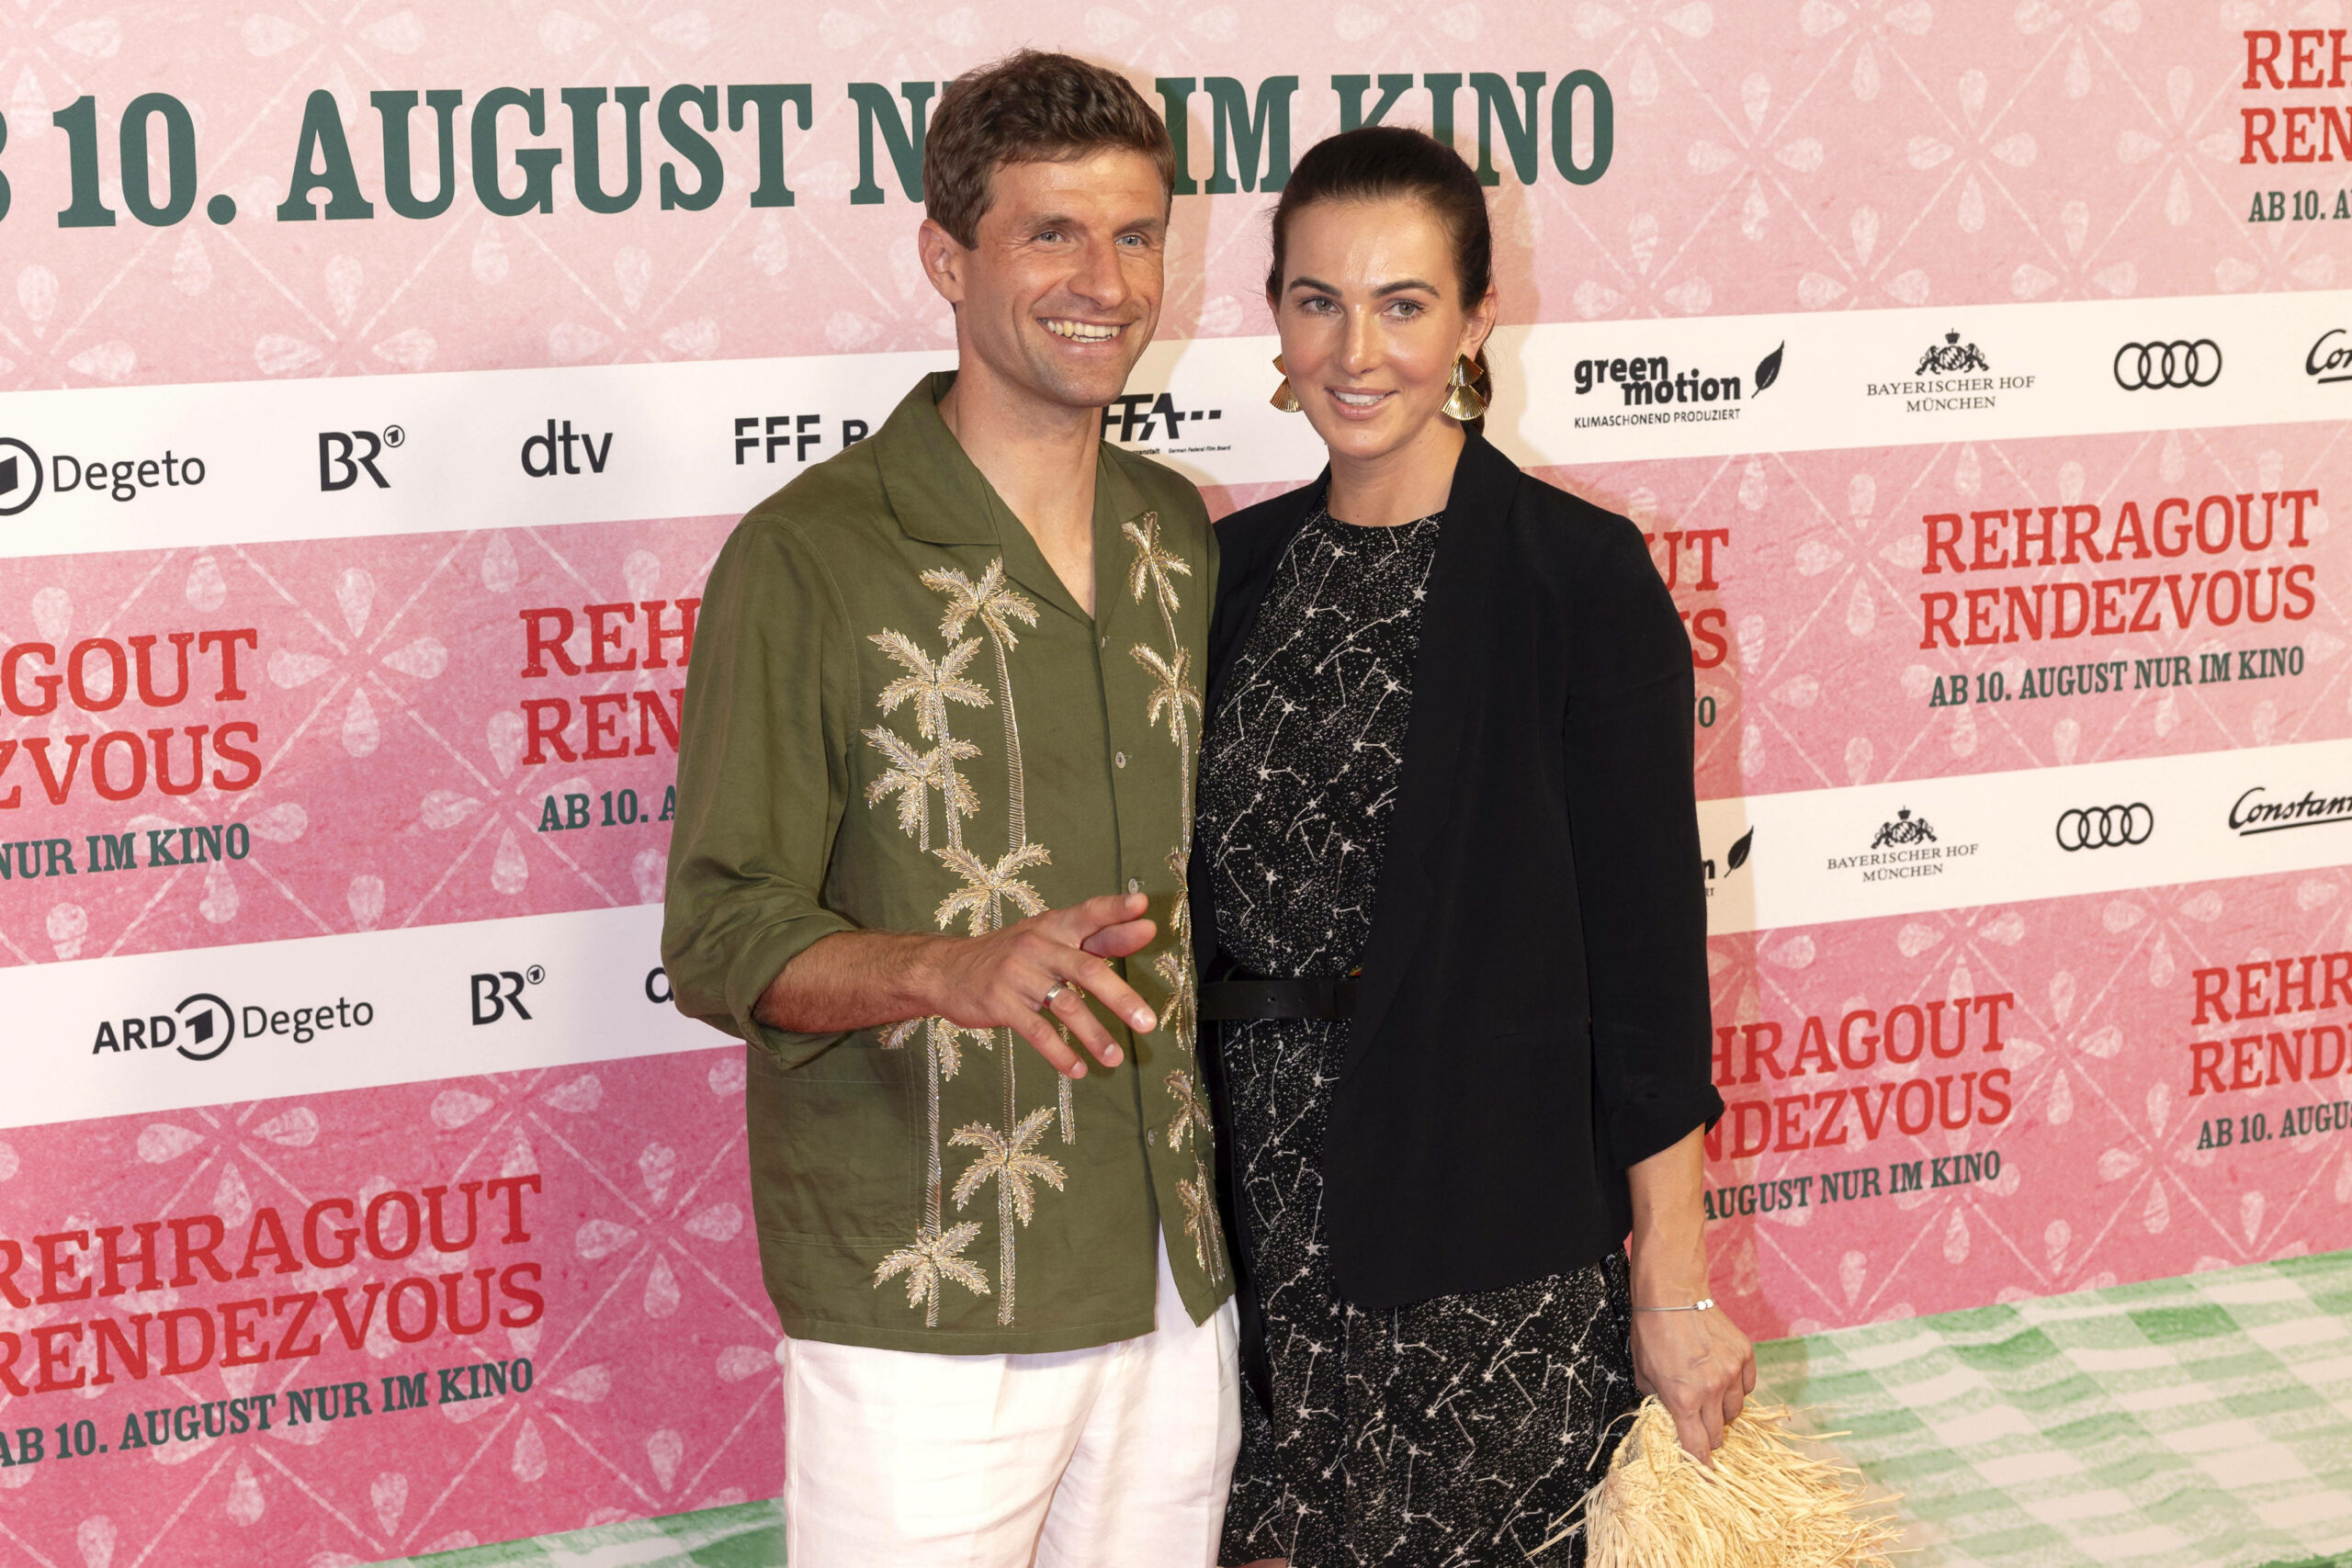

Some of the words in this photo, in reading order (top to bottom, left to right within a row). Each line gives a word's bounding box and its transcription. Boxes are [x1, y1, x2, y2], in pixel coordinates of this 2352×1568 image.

[52, 93, 237, 228] 10.
[277, 84, 813, 221] AUGUST
[847, 81, 952, 206] N
[1154, 75, 1299, 196] IM
[2240, 107, 2352, 164] REN
[2248, 191, 2285, 222] AB
[2292, 190, 2325, 220] 10.
[2331, 187, 2352, 220] A
[1574, 355, 1668, 395] green
[1621, 367, 1741, 406] motion
[1866, 378, 1995, 397] BAYERISCHER
[1998, 375, 2036, 389] HOF
[1575, 412, 1671, 429] KLIMASCHONEND
[1673, 408, 1741, 423] PRODUZIERT
[1905, 395, 1996, 413] MÜNCHEN
[319, 428, 390, 492] BR
[521, 419, 614, 478] dtv
[734, 414, 821, 465] FFF
[52, 450, 206, 502] Degeto
[1921, 488, 2320, 575] REHRAGOUT
[1919, 563, 2316, 650] RENDEZVOUS
[518, 597, 701, 679] REH
[0, 627, 258, 716] GOUT
[1929, 675, 1968, 707] AB
[1976, 671, 2011, 703] 10.
[2019, 661, 2127, 700] AUGUST
[2134, 656, 2191, 689] NUR
[2199, 652, 2231, 683] IM
[2239, 646, 2303, 680] KINO
[519, 687, 685, 766] REN
[537, 793, 590, 832] AB
[601, 789, 649, 826] 10.
[85, 832, 137, 873] IM
[146, 823, 249, 867] KINO
[1826, 846, 1941, 871] BAYERISCHER
[1946, 842, 1980, 858] HOF
[1861, 863, 1944, 883] MÜNCHEN
[93, 1015, 178, 1055] ARD
[243, 997, 374, 1043] Degeto
[469, 969, 534, 1027] BR
[2188, 1021, 2352, 1098] REND
[2198, 1119, 2232, 1149] AB
[2240, 1112, 2274, 1145] 10.
[2278, 1100, 2352, 1139] AUGU
[1703, 1175, 1814, 1221] AUGUST
[1821, 1168, 1882, 1203] NUR
[1890, 1161, 1922, 1194] IM
[1931, 1151, 2000, 1188] KINO
[56, 1420, 107, 1459] 10.
[119, 1394, 276, 1450] AUGUST
[287, 1382, 372, 1427] NUR
[381, 1372, 428, 1412] IM
[437, 1358, 533, 1404] KINO
